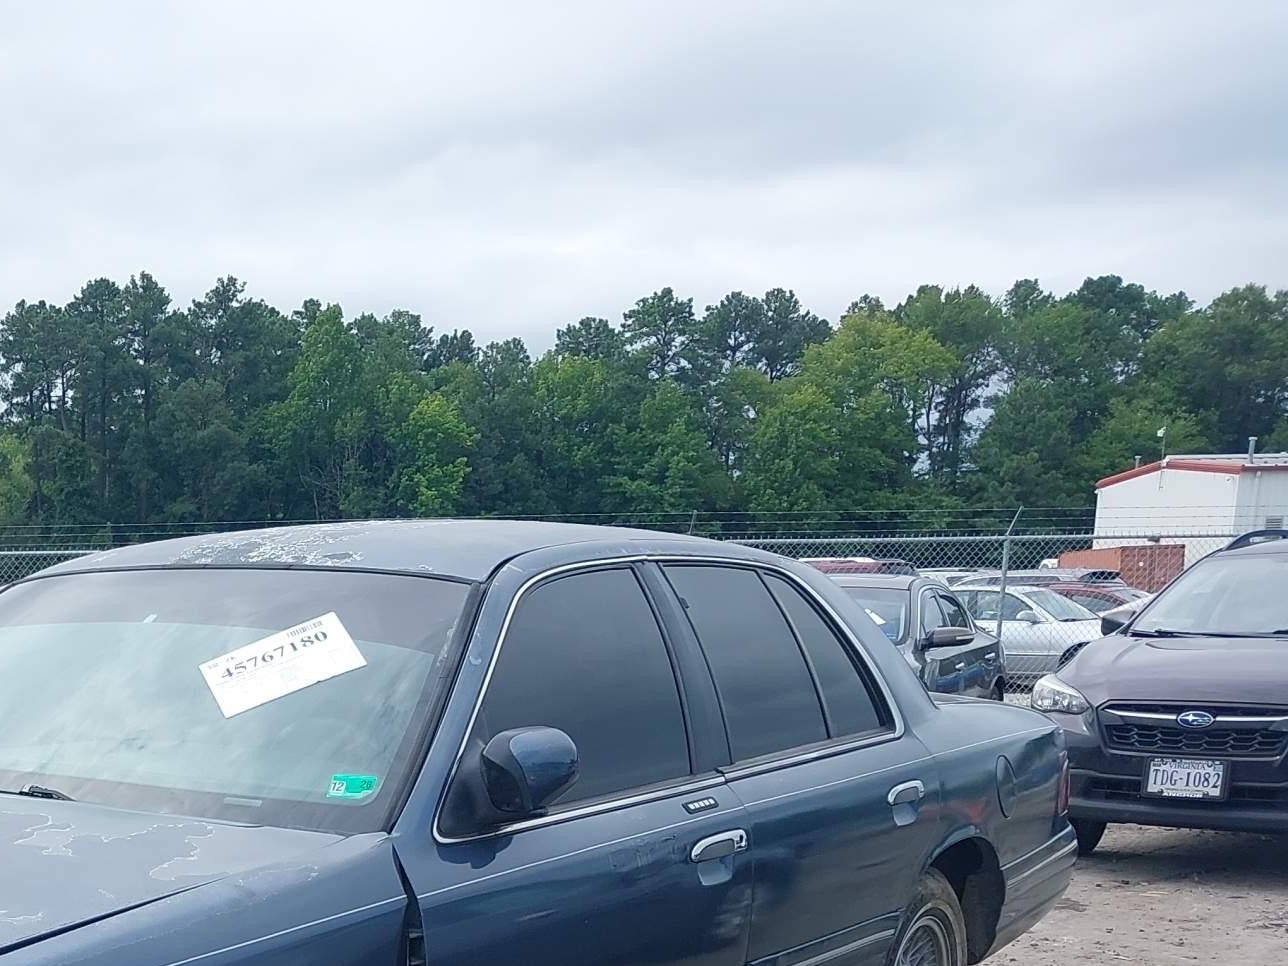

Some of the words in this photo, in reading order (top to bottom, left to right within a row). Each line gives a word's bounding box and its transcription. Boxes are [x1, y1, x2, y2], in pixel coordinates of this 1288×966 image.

[221, 631, 328, 679] 45767180
[1169, 761, 1206, 770] VIRGINIA
[1152, 769, 1221, 788] TDG-1082
[331, 782, 345, 792] 12
